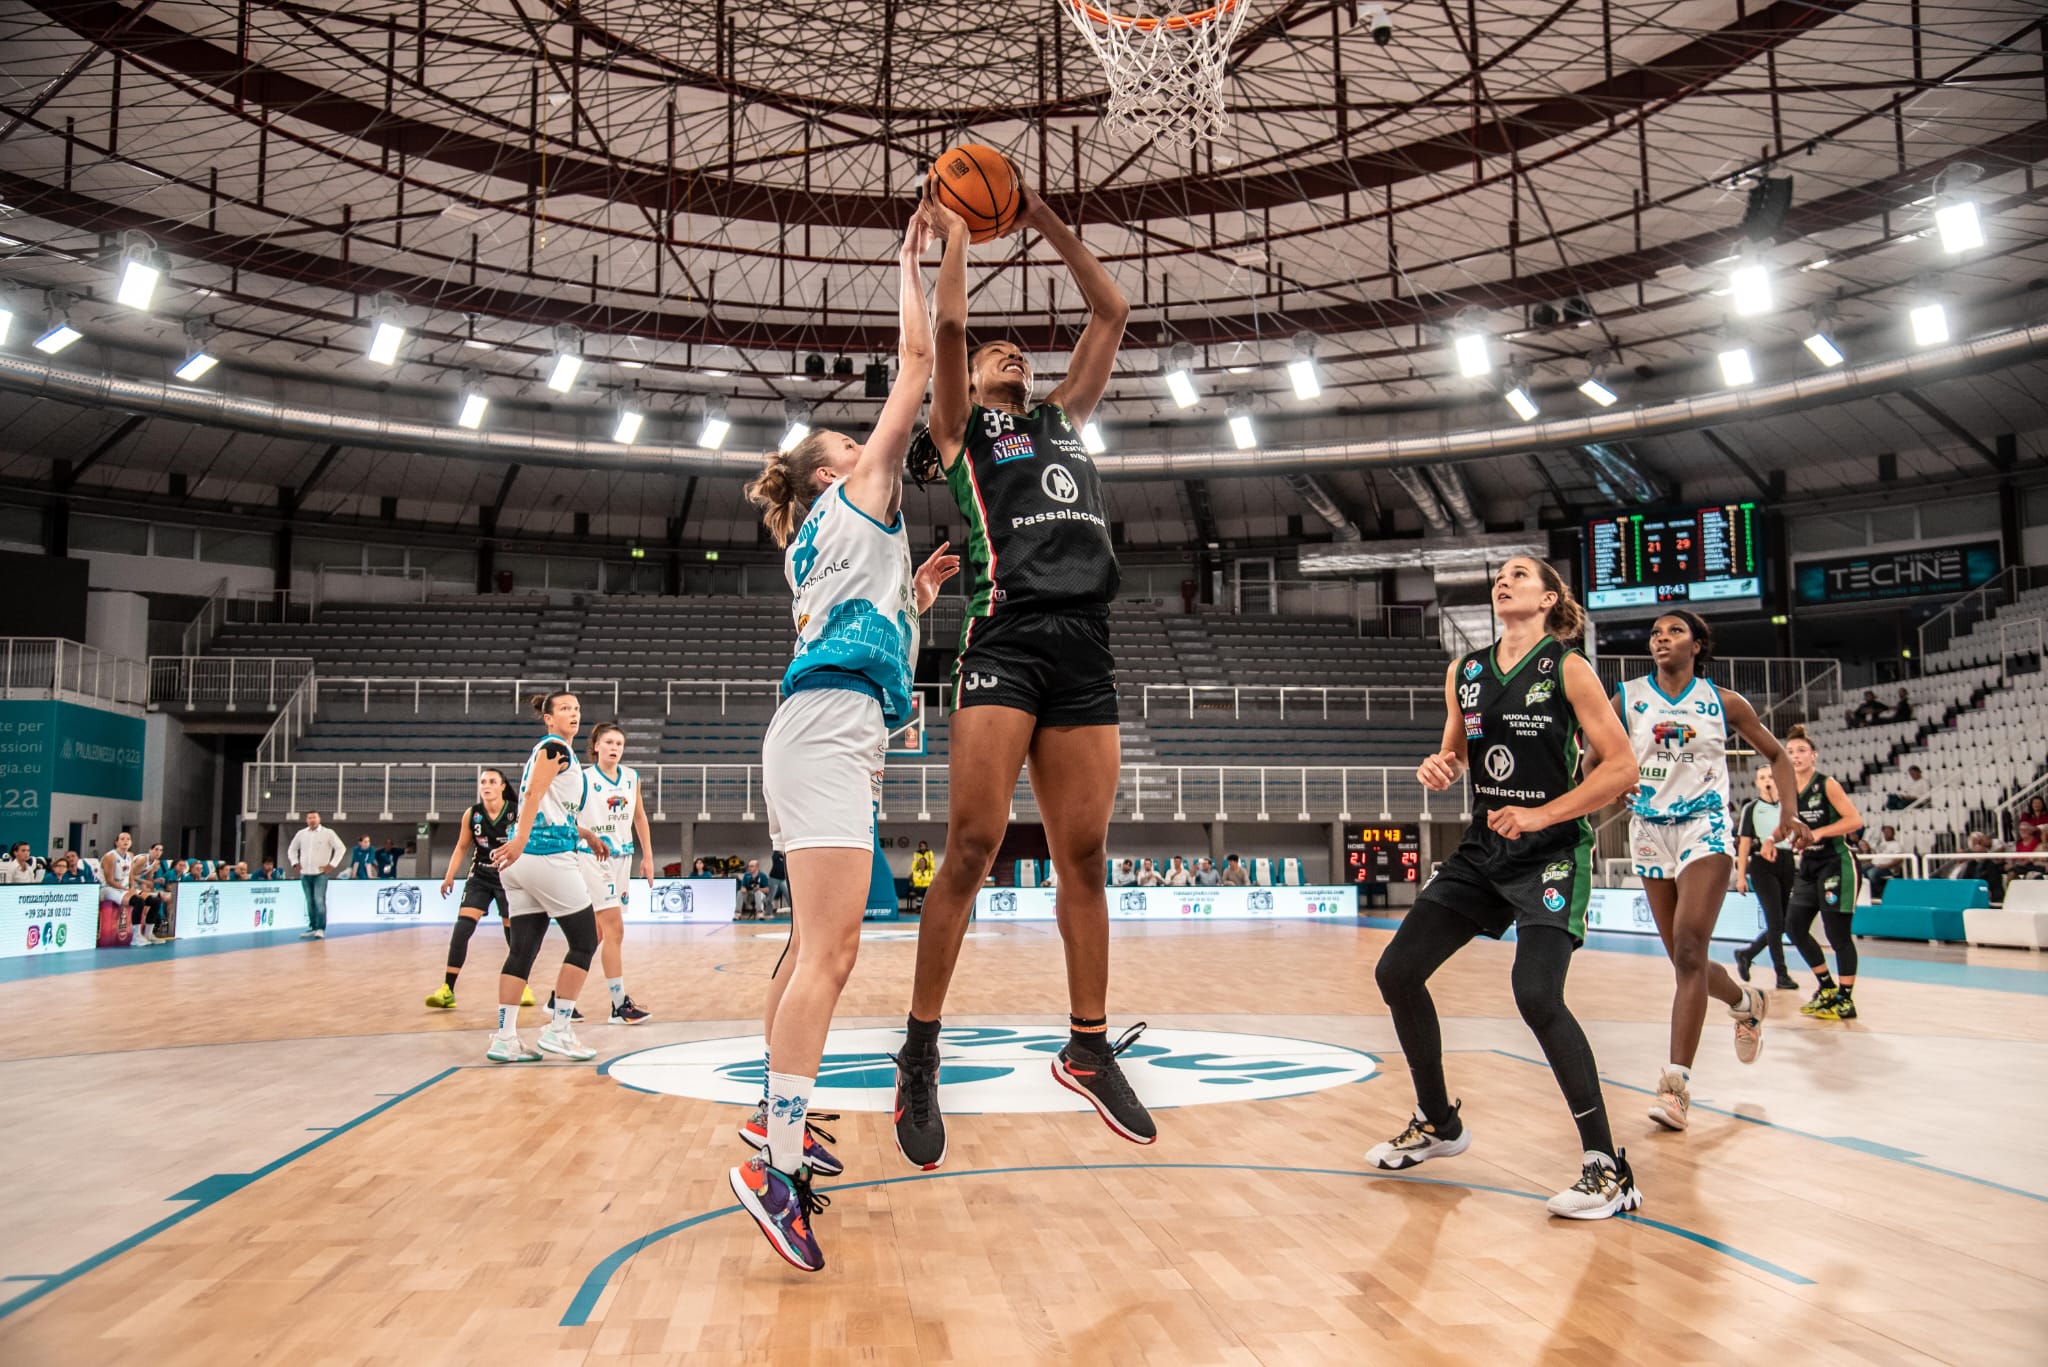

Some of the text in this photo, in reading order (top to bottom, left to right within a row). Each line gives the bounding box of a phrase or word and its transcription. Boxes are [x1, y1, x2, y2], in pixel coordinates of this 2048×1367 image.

[993, 445, 1034, 461] Maria
[1012, 508, 1105, 529] Passalacqua
[1647, 541, 1661, 553] 21
[1893, 550, 1960, 563] METROLOGIA
[1828, 557, 1962, 590] TECHNE
[1658, 583, 1686, 595] 07:43
[1694, 701, 1719, 716] 30
[1502, 713, 1530, 721] NUOVA
[18, 721, 45, 736] per
[1509, 721, 1545, 729] SERVICE
[0, 741, 43, 753] ssioni
[0, 788, 39, 809] 2a
[474, 823, 482, 836] 3
[1384, 829, 1401, 842] 43
[1350, 852, 1366, 865] 21
[1401, 852, 1418, 865] 29
[1358, 868, 1367, 880] 2
[1407, 868, 1416, 880] 0
[607, 883, 615, 895] 7
[18, 891, 79, 906] ronzaniphoto.com
